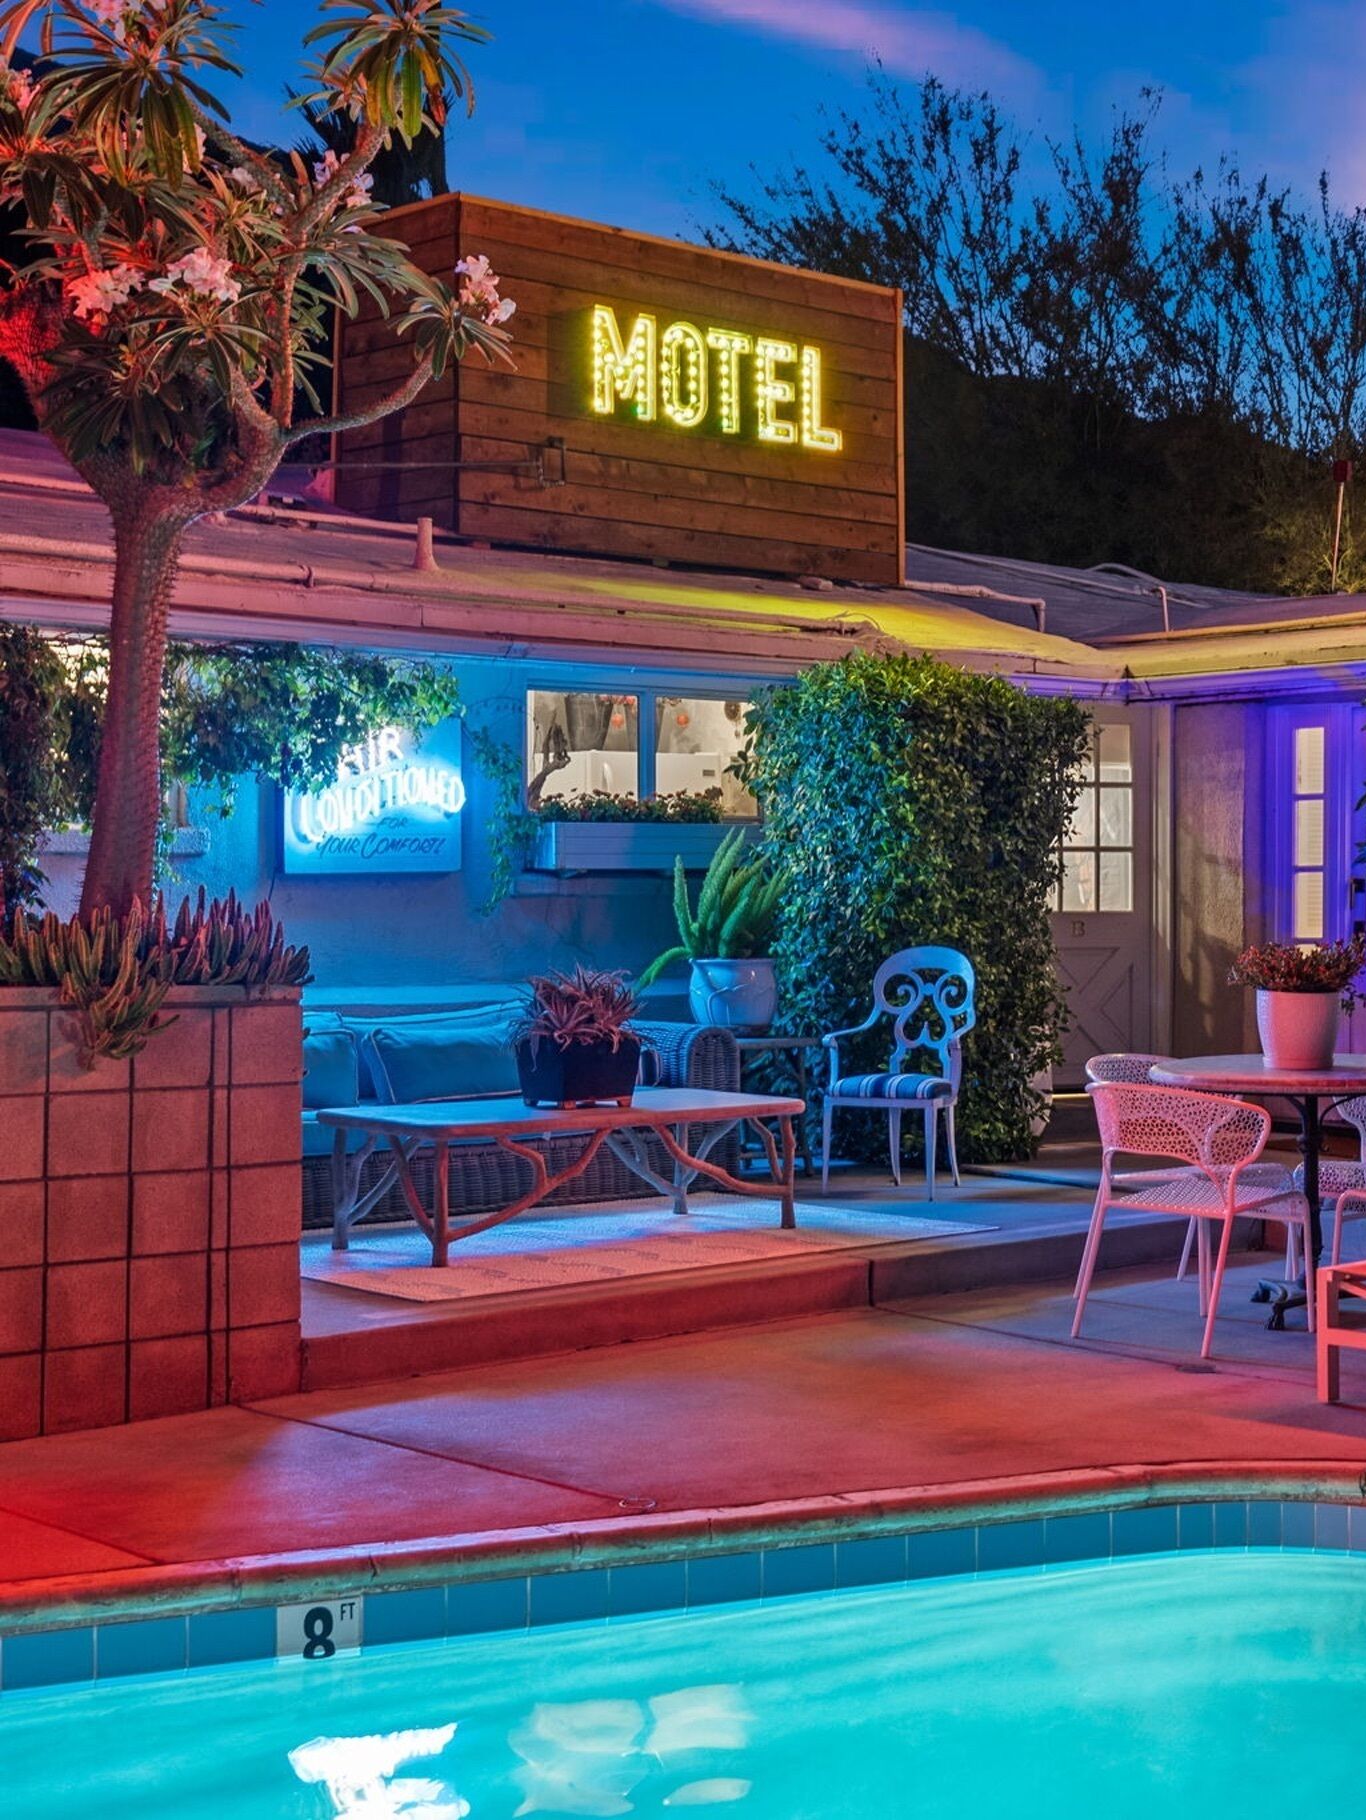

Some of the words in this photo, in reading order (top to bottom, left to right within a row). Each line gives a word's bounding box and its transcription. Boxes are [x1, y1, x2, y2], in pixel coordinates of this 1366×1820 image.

[594, 304, 843, 451] MOTEL
[298, 766, 467, 844] CONDITIONED
[376, 816, 408, 830] FOR
[317, 834, 361, 858] YOUR
[303, 1607, 335, 1659] 8
[341, 1603, 355, 1620] FT
